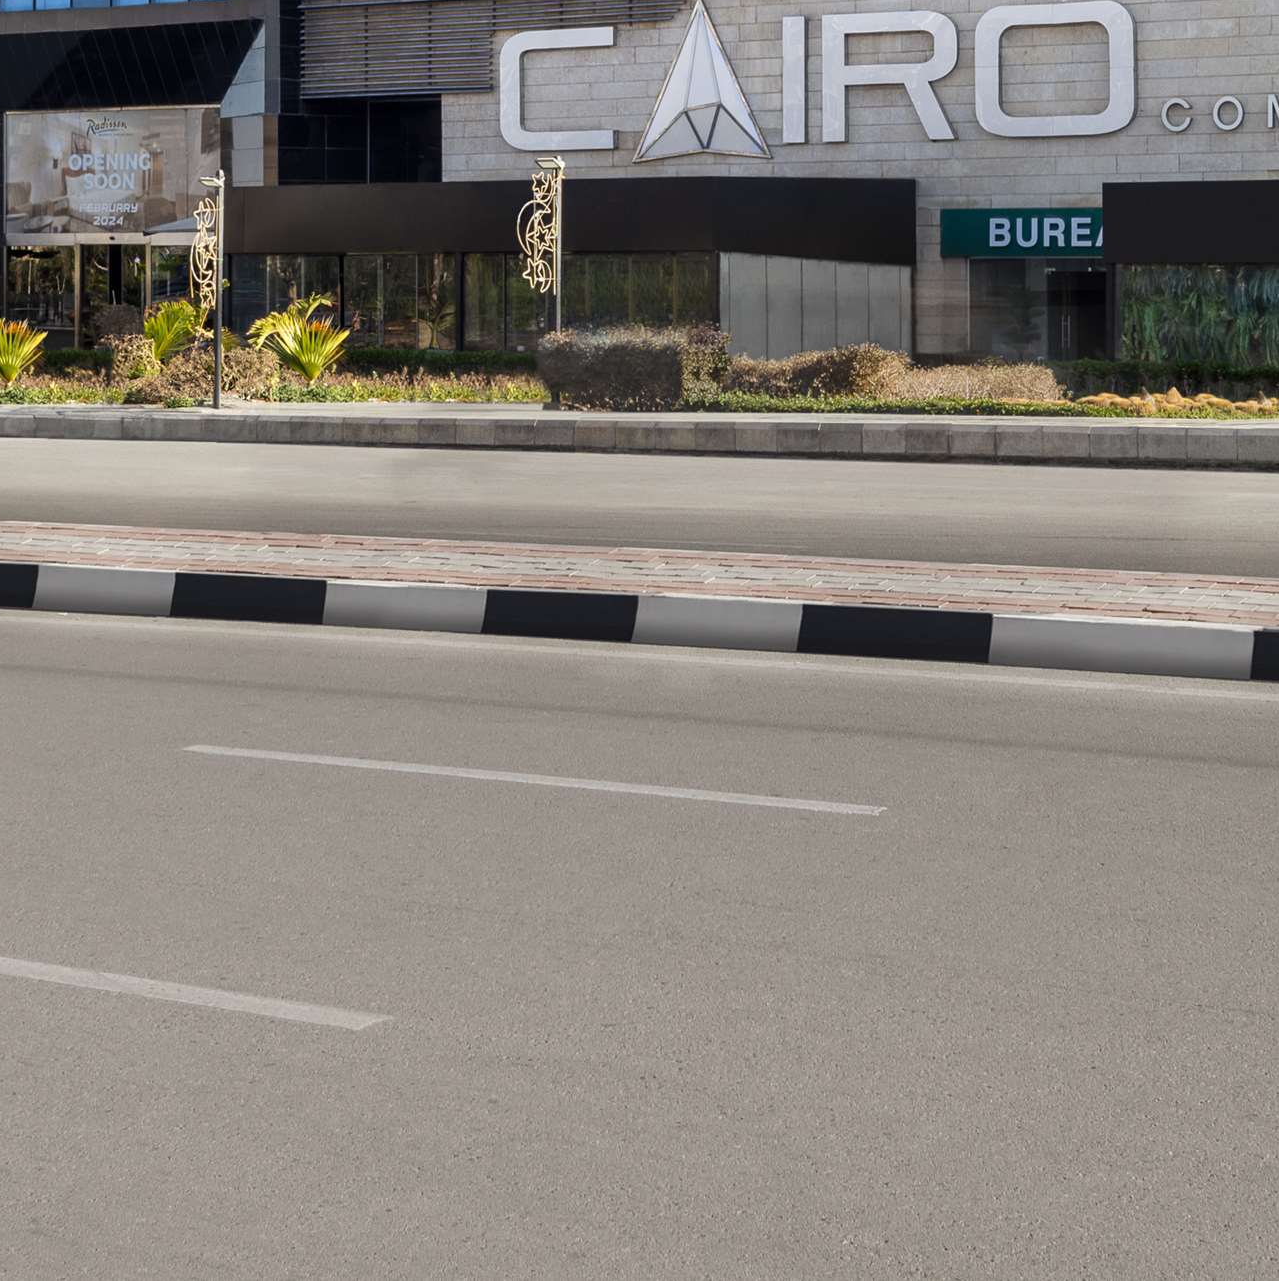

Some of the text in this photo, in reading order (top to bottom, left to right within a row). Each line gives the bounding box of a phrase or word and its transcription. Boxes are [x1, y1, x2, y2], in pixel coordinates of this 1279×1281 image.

[86, 116, 128, 138] Radisson
[68, 152, 152, 171] OPENING
[83, 172, 136, 190] SOON
[79, 202, 138, 213] FEBRUARY
[93, 215, 124, 226] 2024
